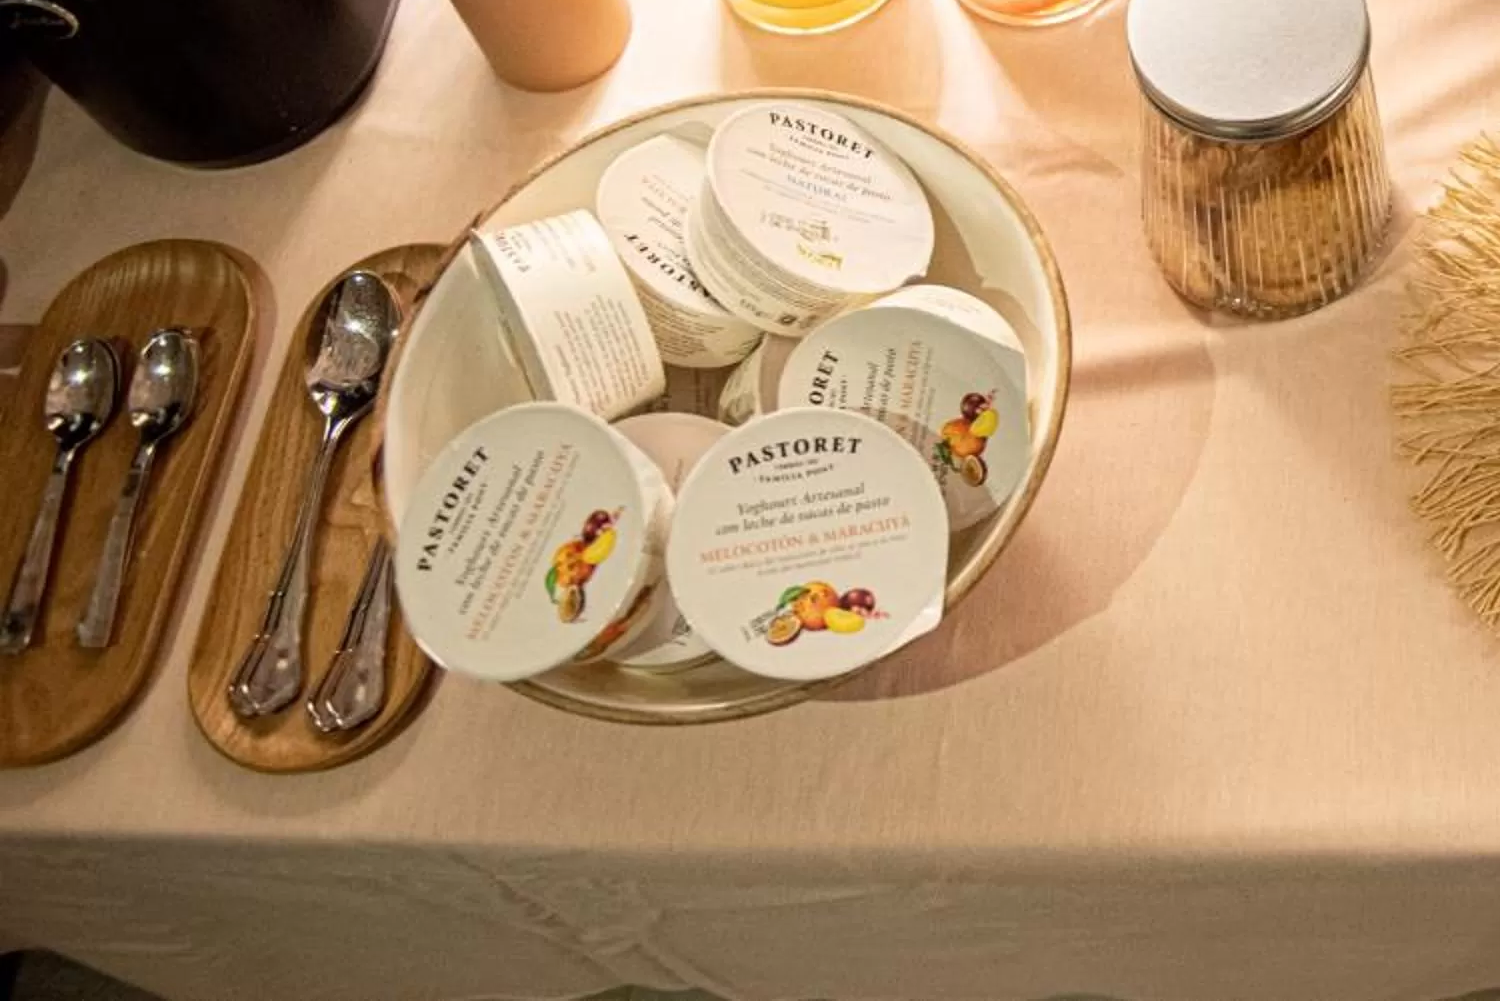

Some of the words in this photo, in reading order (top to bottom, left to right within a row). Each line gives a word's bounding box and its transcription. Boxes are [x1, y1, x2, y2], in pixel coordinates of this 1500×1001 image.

[769, 112, 875, 159] PASTORET
[808, 349, 840, 406] ORET
[728, 436, 863, 475] PASTORET
[416, 446, 489, 572] PASTORET
